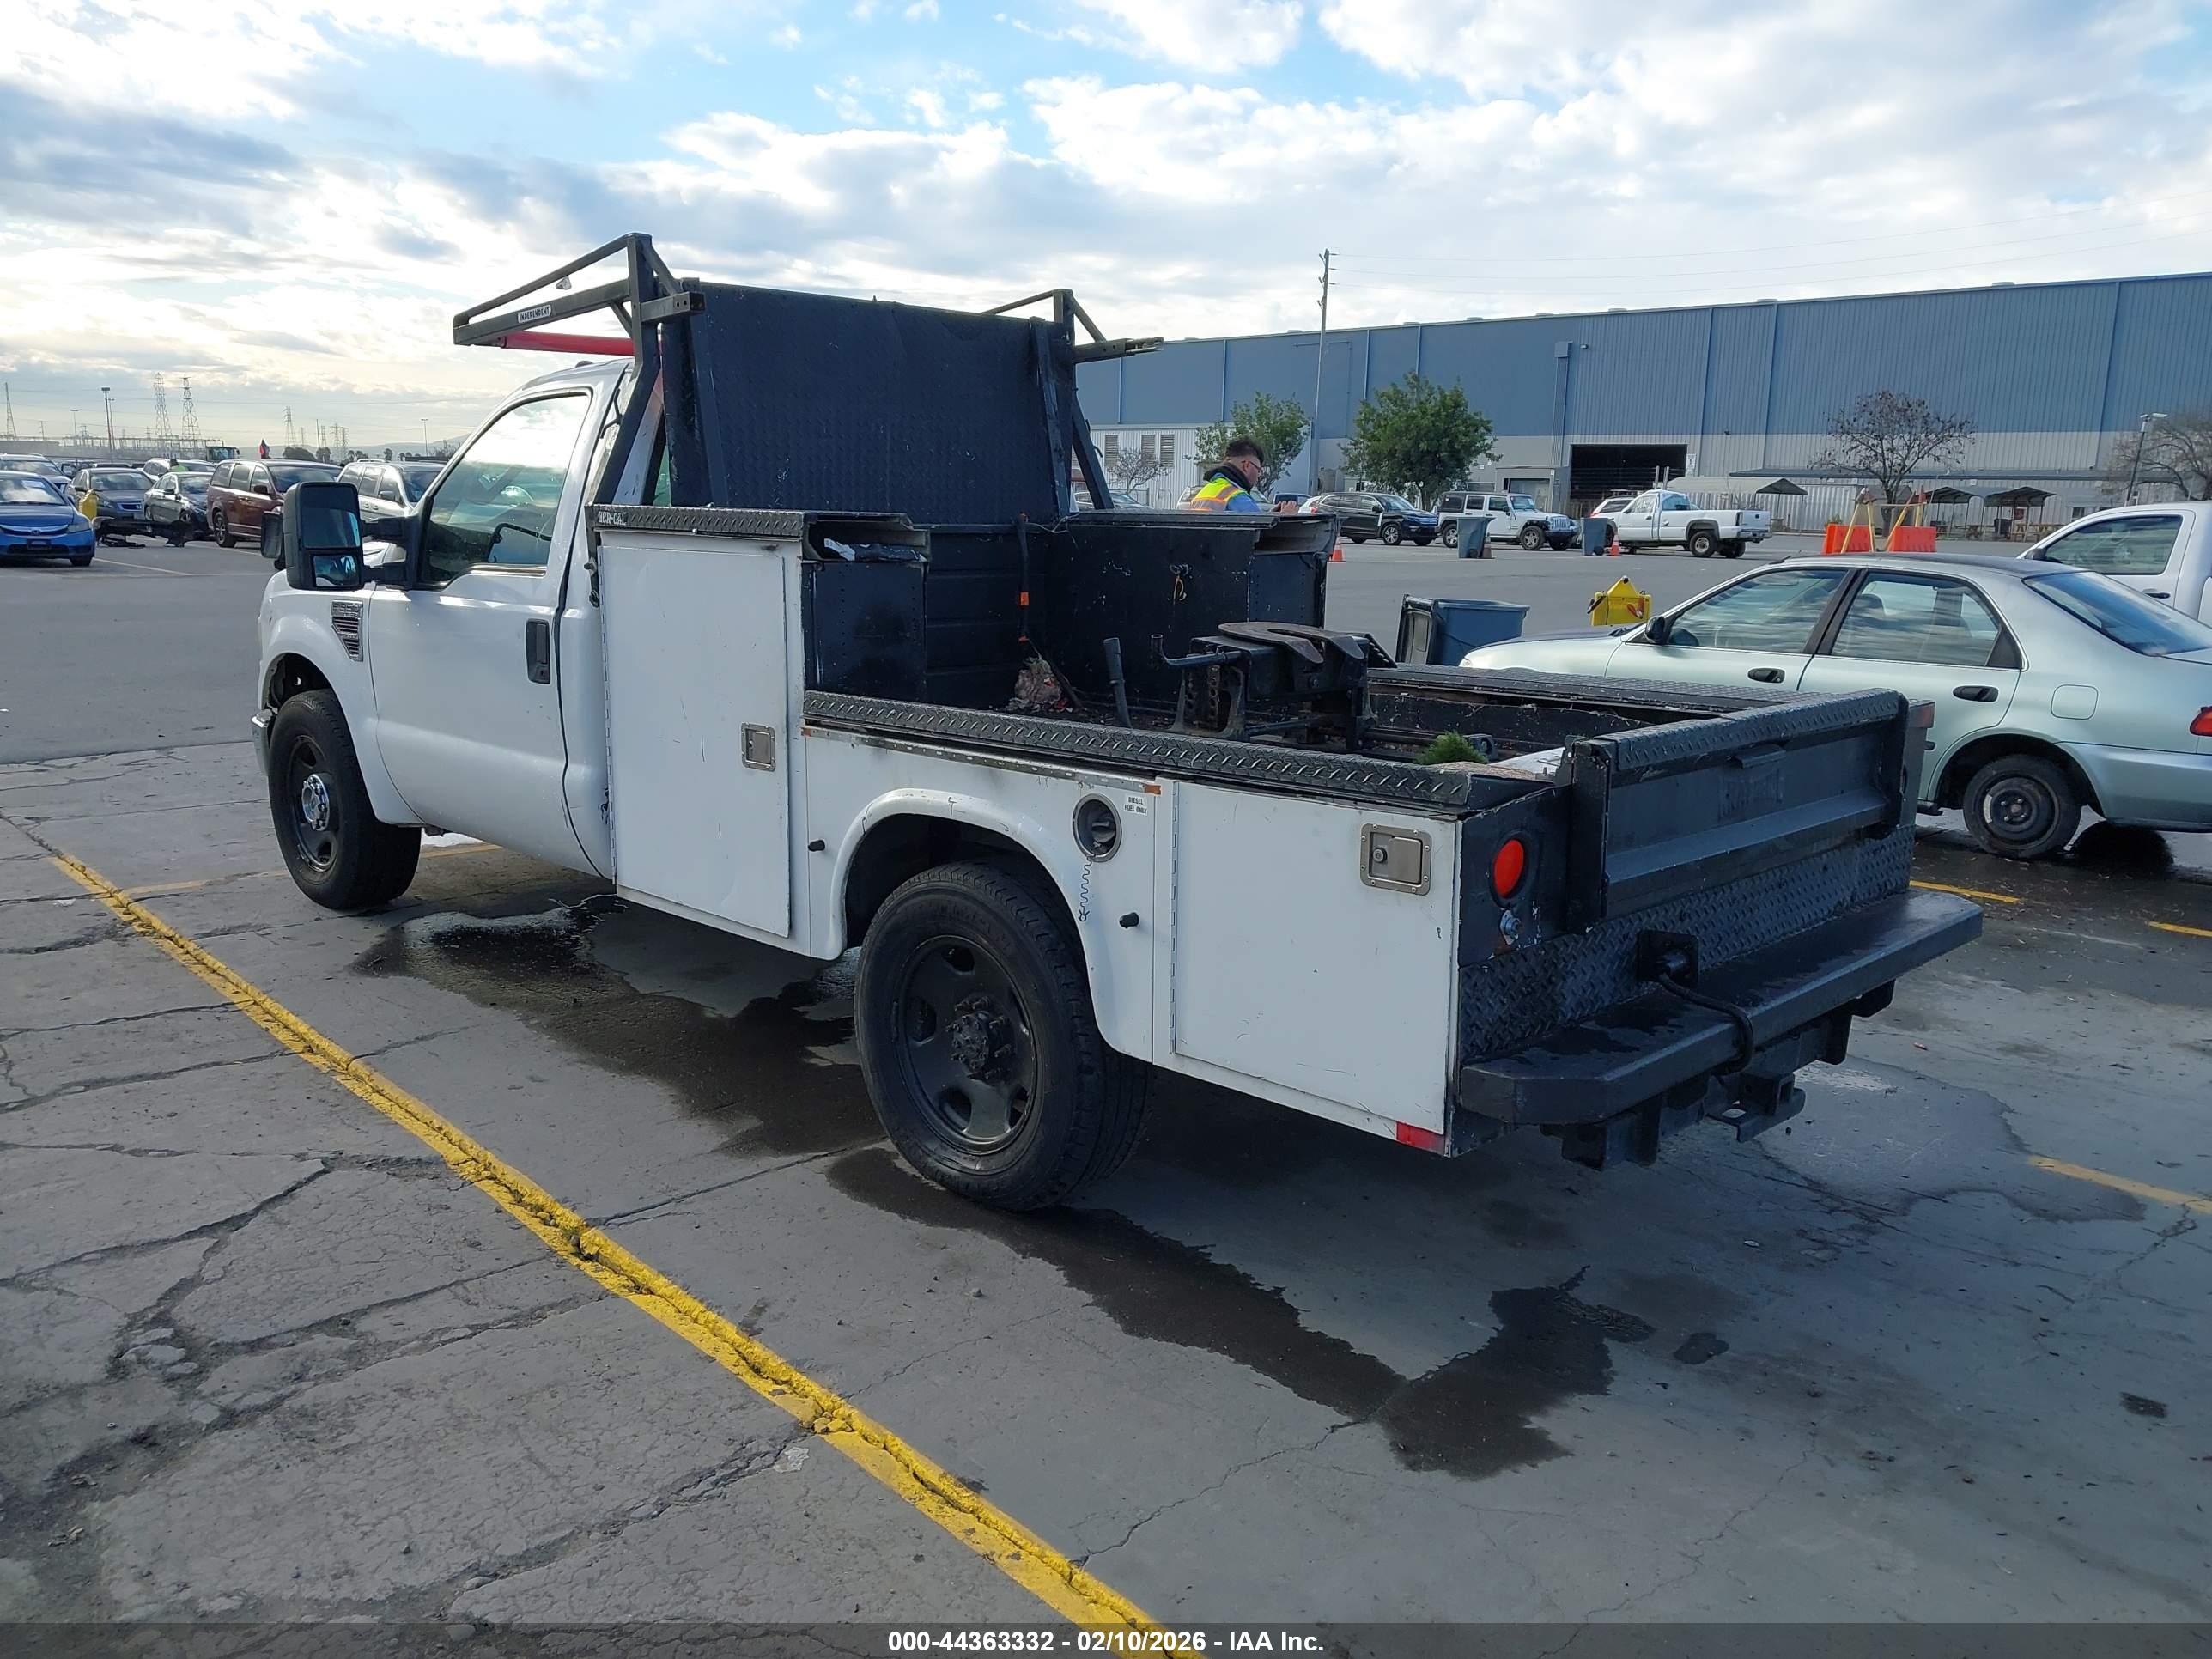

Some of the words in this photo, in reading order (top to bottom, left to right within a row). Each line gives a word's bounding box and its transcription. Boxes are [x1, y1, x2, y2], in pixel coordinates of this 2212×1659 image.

[519, 307, 550, 322] INDEPENDENT
[1127, 796, 1144, 805] DIESEL
[1124, 804, 1136, 812] FUEL
